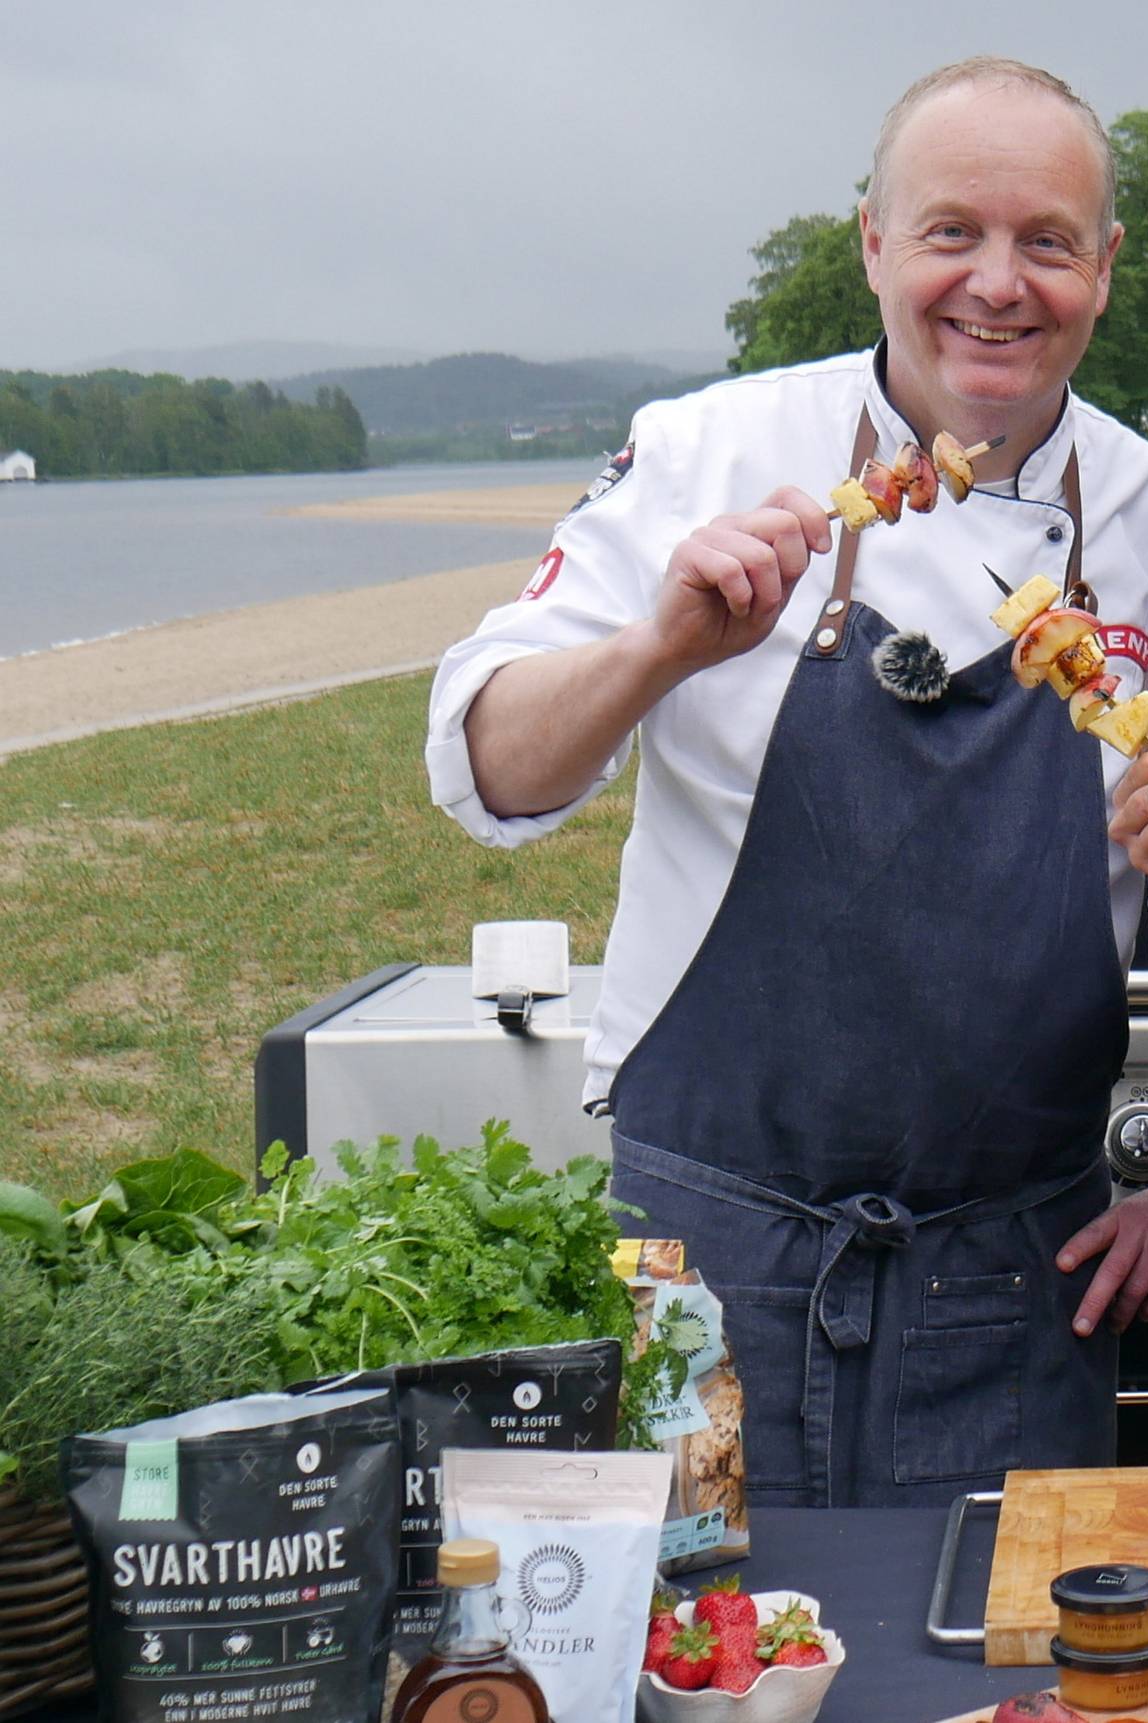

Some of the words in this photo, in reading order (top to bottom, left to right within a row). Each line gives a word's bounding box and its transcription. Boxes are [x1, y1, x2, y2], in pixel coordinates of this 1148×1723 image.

[491, 1416, 516, 1428] DEN
[521, 1415, 562, 1428] SORTE
[506, 1432, 546, 1443] HAVRE
[134, 1466, 169, 1480] STORE
[279, 1481, 301, 1496] DEN
[304, 1475, 338, 1492] SORTE
[292, 1495, 326, 1511] HAVRE
[402, 1519, 429, 1532] GRYN
[113, 1526, 347, 1587] SVARTHAVRE
[136, 1598, 204, 1615] HAVREGRYN
[207, 1597, 223, 1612] AV
[227, 1594, 261, 1610] 100%
[265, 1588, 298, 1607] NORSK
[320, 1576, 361, 1598] URHAVRE
[424, 1607, 441, 1619] SUN
[513, 1637, 595, 1655] NDLER
[160, 1692, 189, 1707] 40%
[193, 1690, 217, 1705] MER
[220, 1687, 255, 1704] SUNNE
[259, 1679, 317, 1700] FETTSYRER
[164, 1708, 187, 1722] ENN
[199, 1703, 248, 1721] MODERNE
[253, 1701, 278, 1716] HVIT
[281, 1695, 311, 1712] HAVRE
